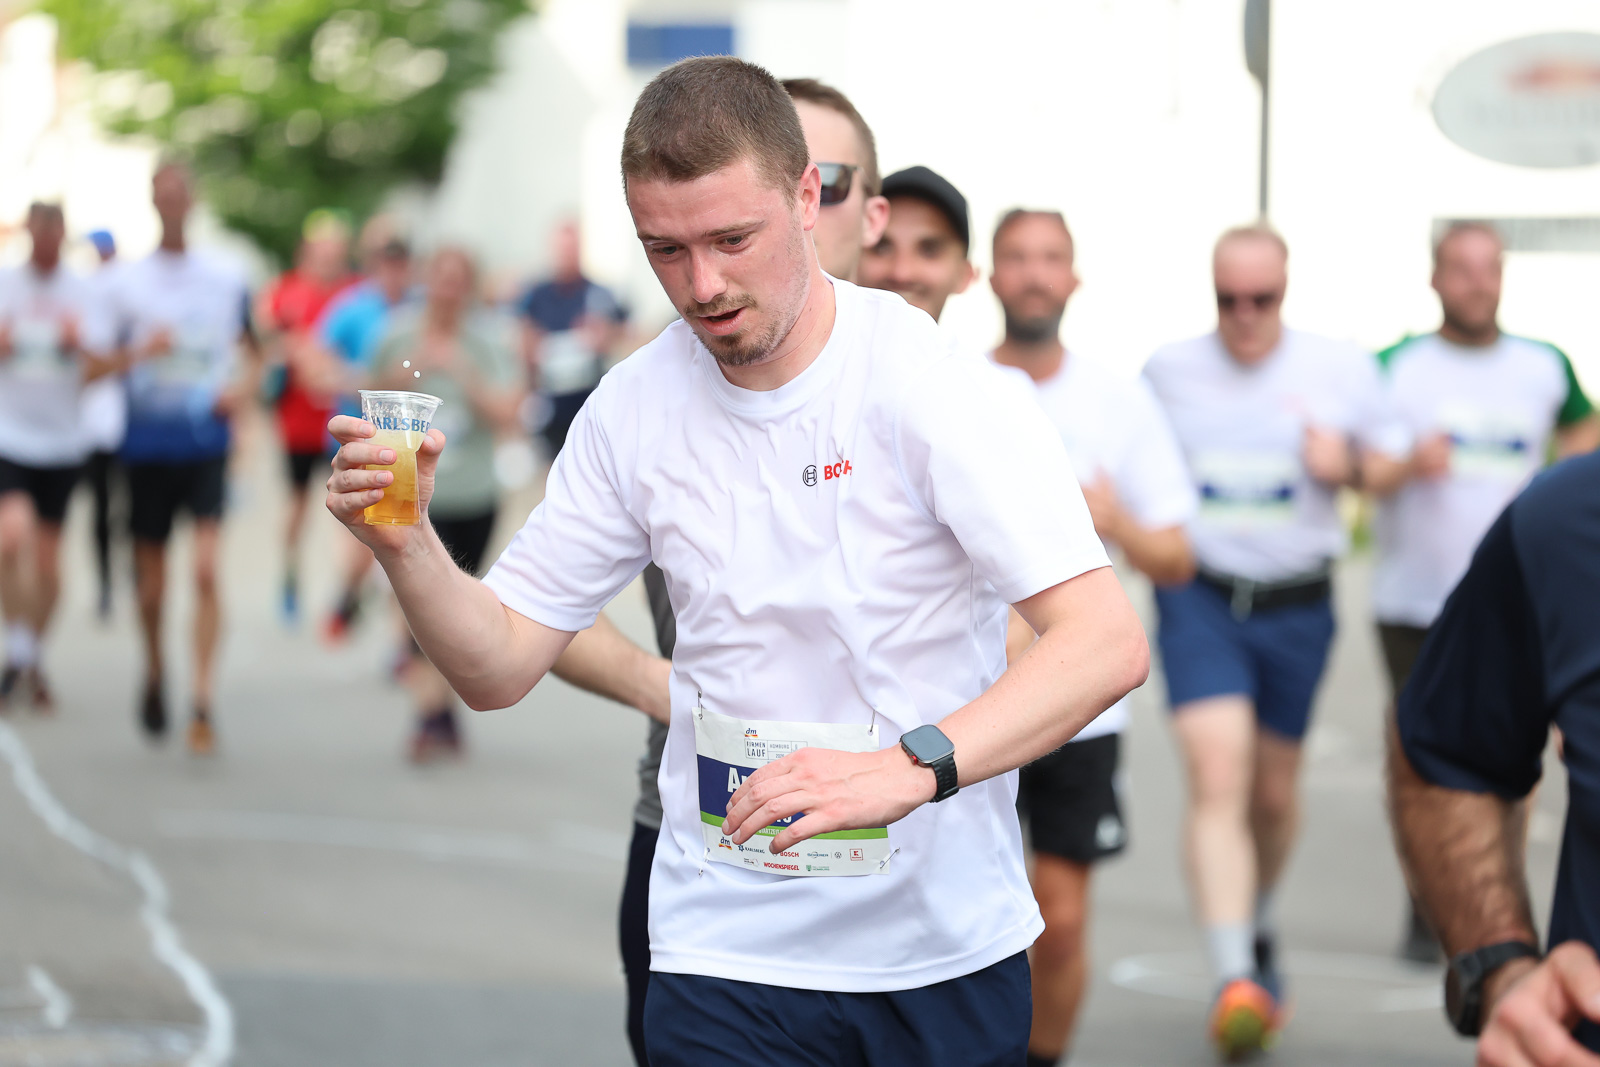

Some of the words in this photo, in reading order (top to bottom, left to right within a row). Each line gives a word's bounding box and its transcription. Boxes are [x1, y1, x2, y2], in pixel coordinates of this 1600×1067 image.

[746, 748, 766, 757] LAUF
[720, 837, 731, 846] dm
[744, 846, 766, 854] KARLSBERG
[763, 861, 800, 871] WOCHENSPIEGEL
